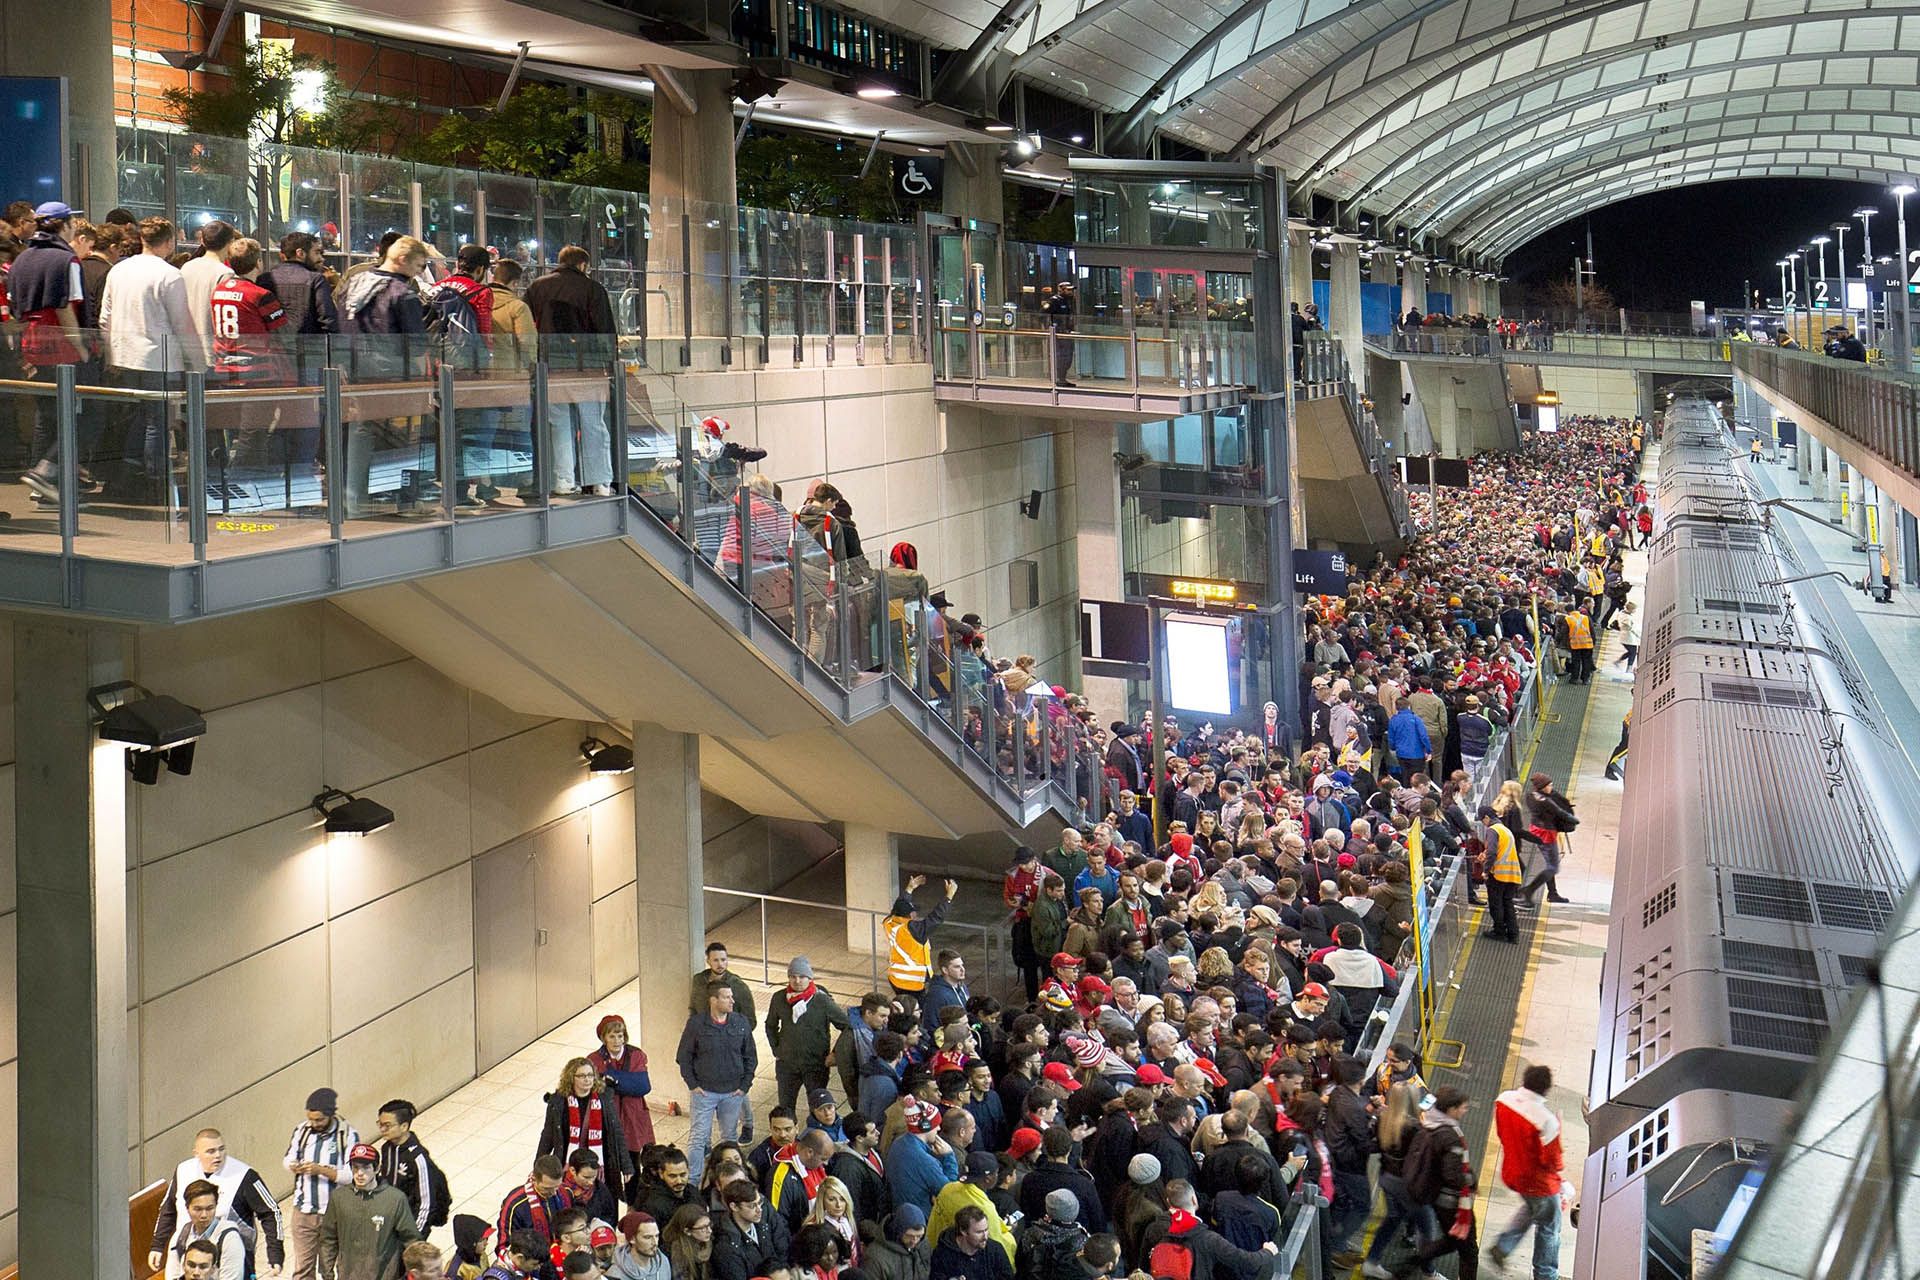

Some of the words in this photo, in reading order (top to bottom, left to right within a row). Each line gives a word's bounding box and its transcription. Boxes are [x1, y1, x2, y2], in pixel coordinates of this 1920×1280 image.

[1786, 291, 1797, 308] 2
[1815, 281, 1829, 302] 2
[213, 303, 240, 339] 18
[1396, 457, 1408, 484] 1
[1295, 573, 1315, 584] Lift
[1082, 602, 1102, 658] 1
